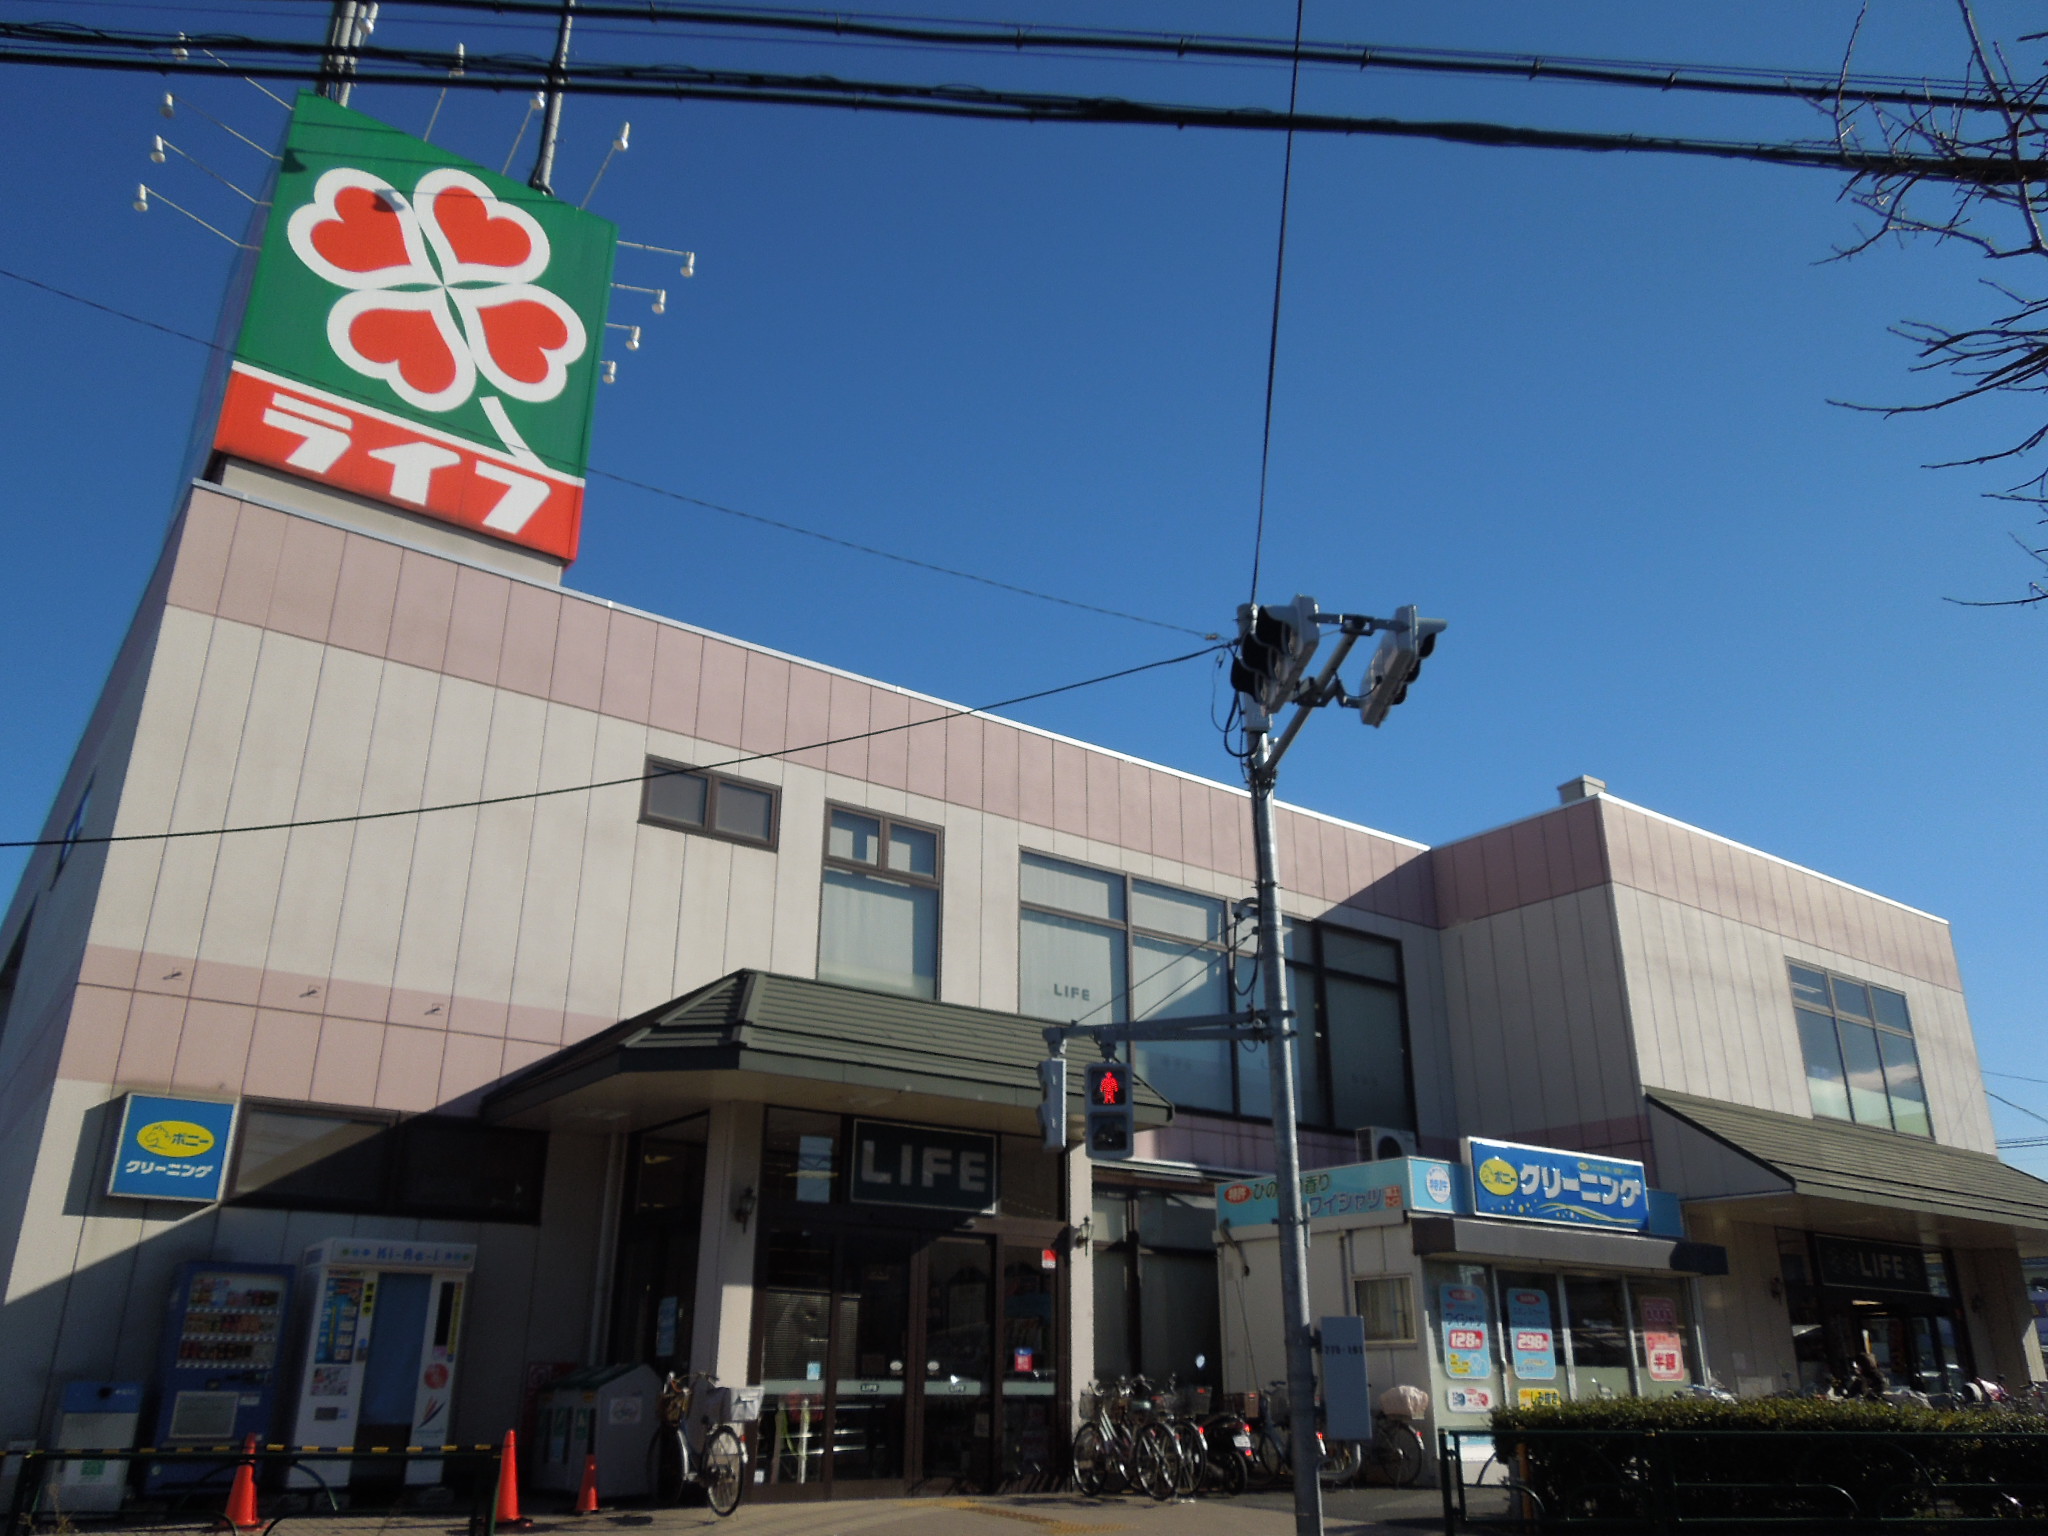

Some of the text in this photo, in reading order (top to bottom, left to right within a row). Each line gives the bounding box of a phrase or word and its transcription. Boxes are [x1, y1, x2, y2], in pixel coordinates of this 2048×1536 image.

[262, 391, 551, 534] ライフ
[1054, 984, 1090, 1001] LIFE
[171, 1133, 210, 1147] ポニー
[125, 1160, 213, 1178] クリーニング
[861, 1140, 987, 1192] LIFE
[1520, 1163, 1641, 1208] クリーニング
[1310, 1188, 1383, 1216] ワイシャツ
[1859, 1252, 1905, 1279] LIFE
